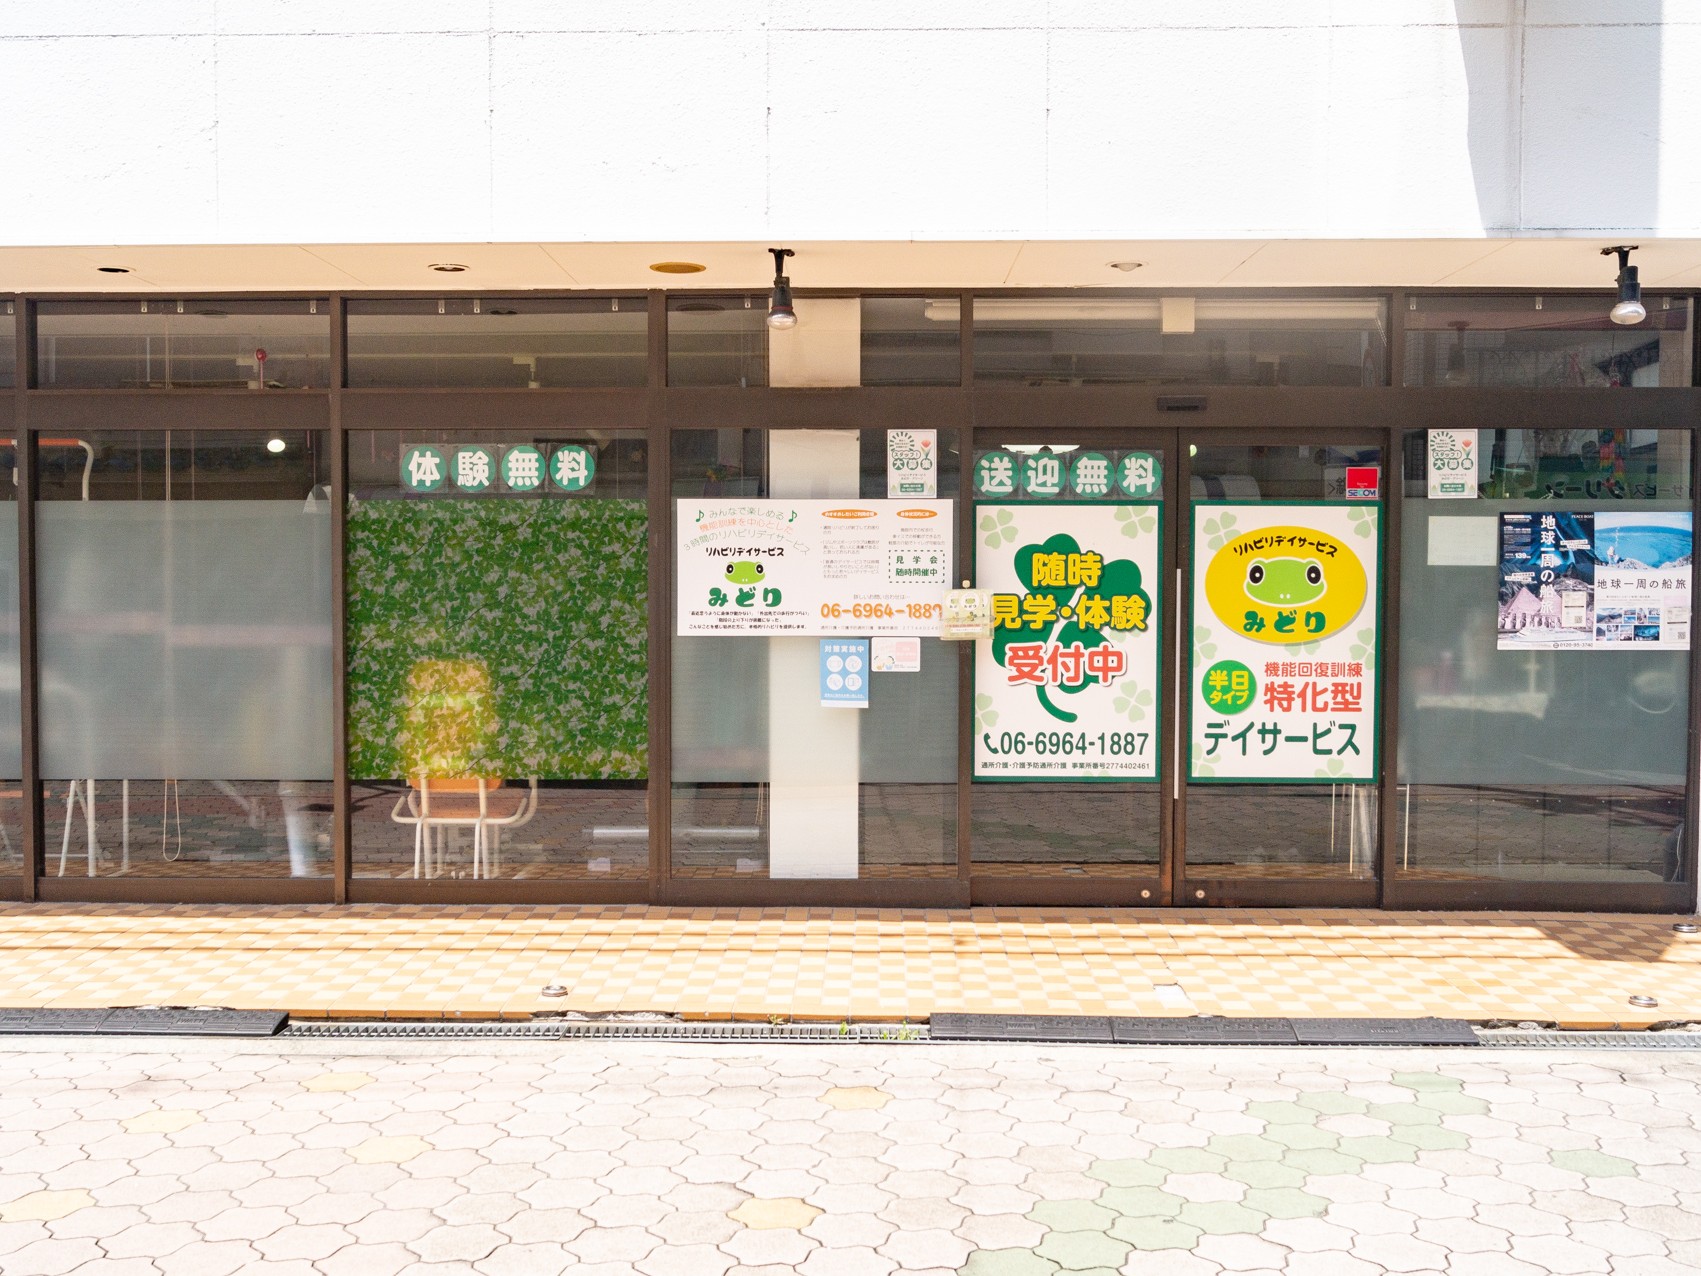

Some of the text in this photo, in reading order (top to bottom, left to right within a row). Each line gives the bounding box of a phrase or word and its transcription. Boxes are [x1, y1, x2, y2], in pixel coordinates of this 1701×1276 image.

[408, 449, 589, 487] 体験無料
[979, 456, 1155, 494] 送迎無料
[1347, 489, 1376, 497] SECOM
[709, 506, 785, 521] みんなで楽しめる
[699, 517, 795, 535] 機能訓練を中心とした
[705, 546, 785, 557] リハビリデイサービス
[1233, 535, 1338, 558] リハビリデイサービス
[896, 555, 938, 565] 見学会
[1032, 551, 1102, 587] 随時
[1540, 514, 1556, 614] 地球一周の船旅
[895, 568, 938, 577] 随時開催中
[1597, 578, 1687, 590] 地球一周の船旅
[707, 586, 783, 608] みどり
[991, 594, 1149, 630] 見学・体験
[1243, 610, 1327, 634] みどり
[1007, 645, 1124, 683] 受付中
[1264, 661, 1363, 678] 機能回復訓練
[1208, 669, 1250, 691] 半日
[1209, 690, 1250, 705] タイプ
[1263, 680, 1363, 713] 特化型
[1000, 731, 1150, 756] 06-6964-1887
[1204, 719, 1361, 757] デイサービス
